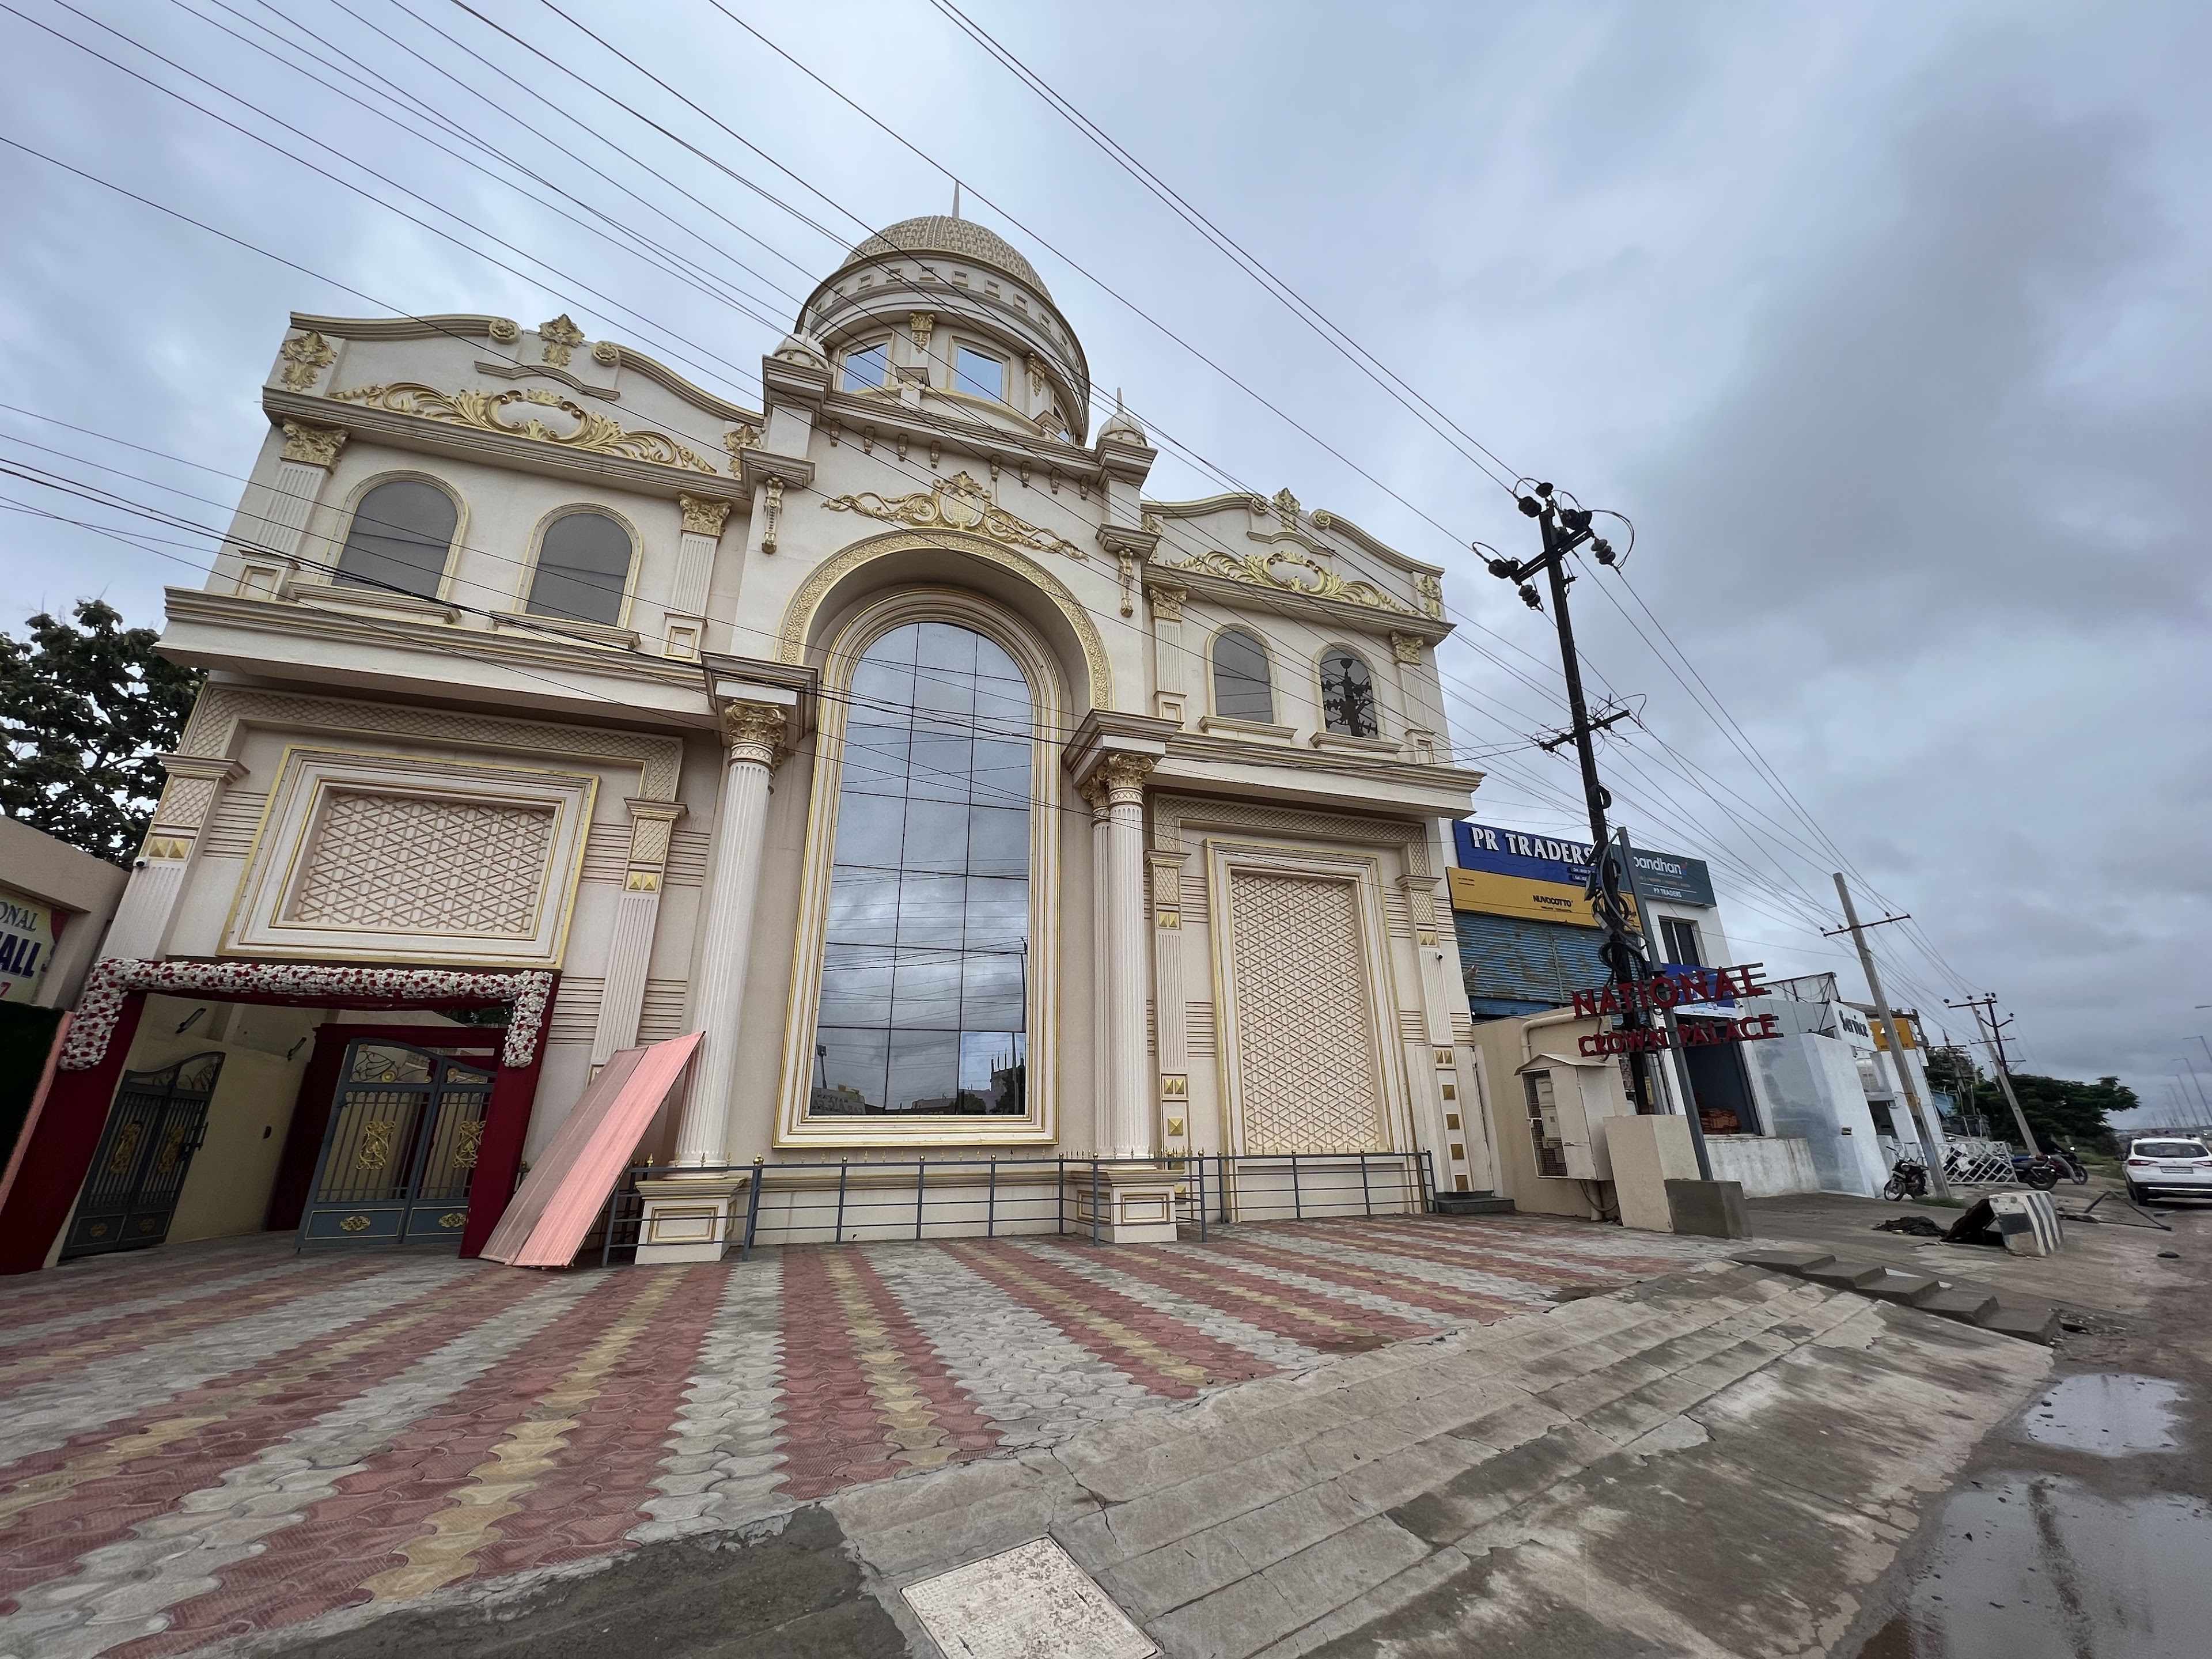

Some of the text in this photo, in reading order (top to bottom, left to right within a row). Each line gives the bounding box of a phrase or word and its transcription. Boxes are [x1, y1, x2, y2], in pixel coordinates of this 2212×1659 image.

[1471, 827, 1499, 851] PR
[1532, 895, 1572, 907] NUVOCOTTO
[0, 931, 42, 979] ALL
[1571, 965, 1766, 1019] NATIONAL
[1578, 1013, 1779, 1057] CROWN PALACE
